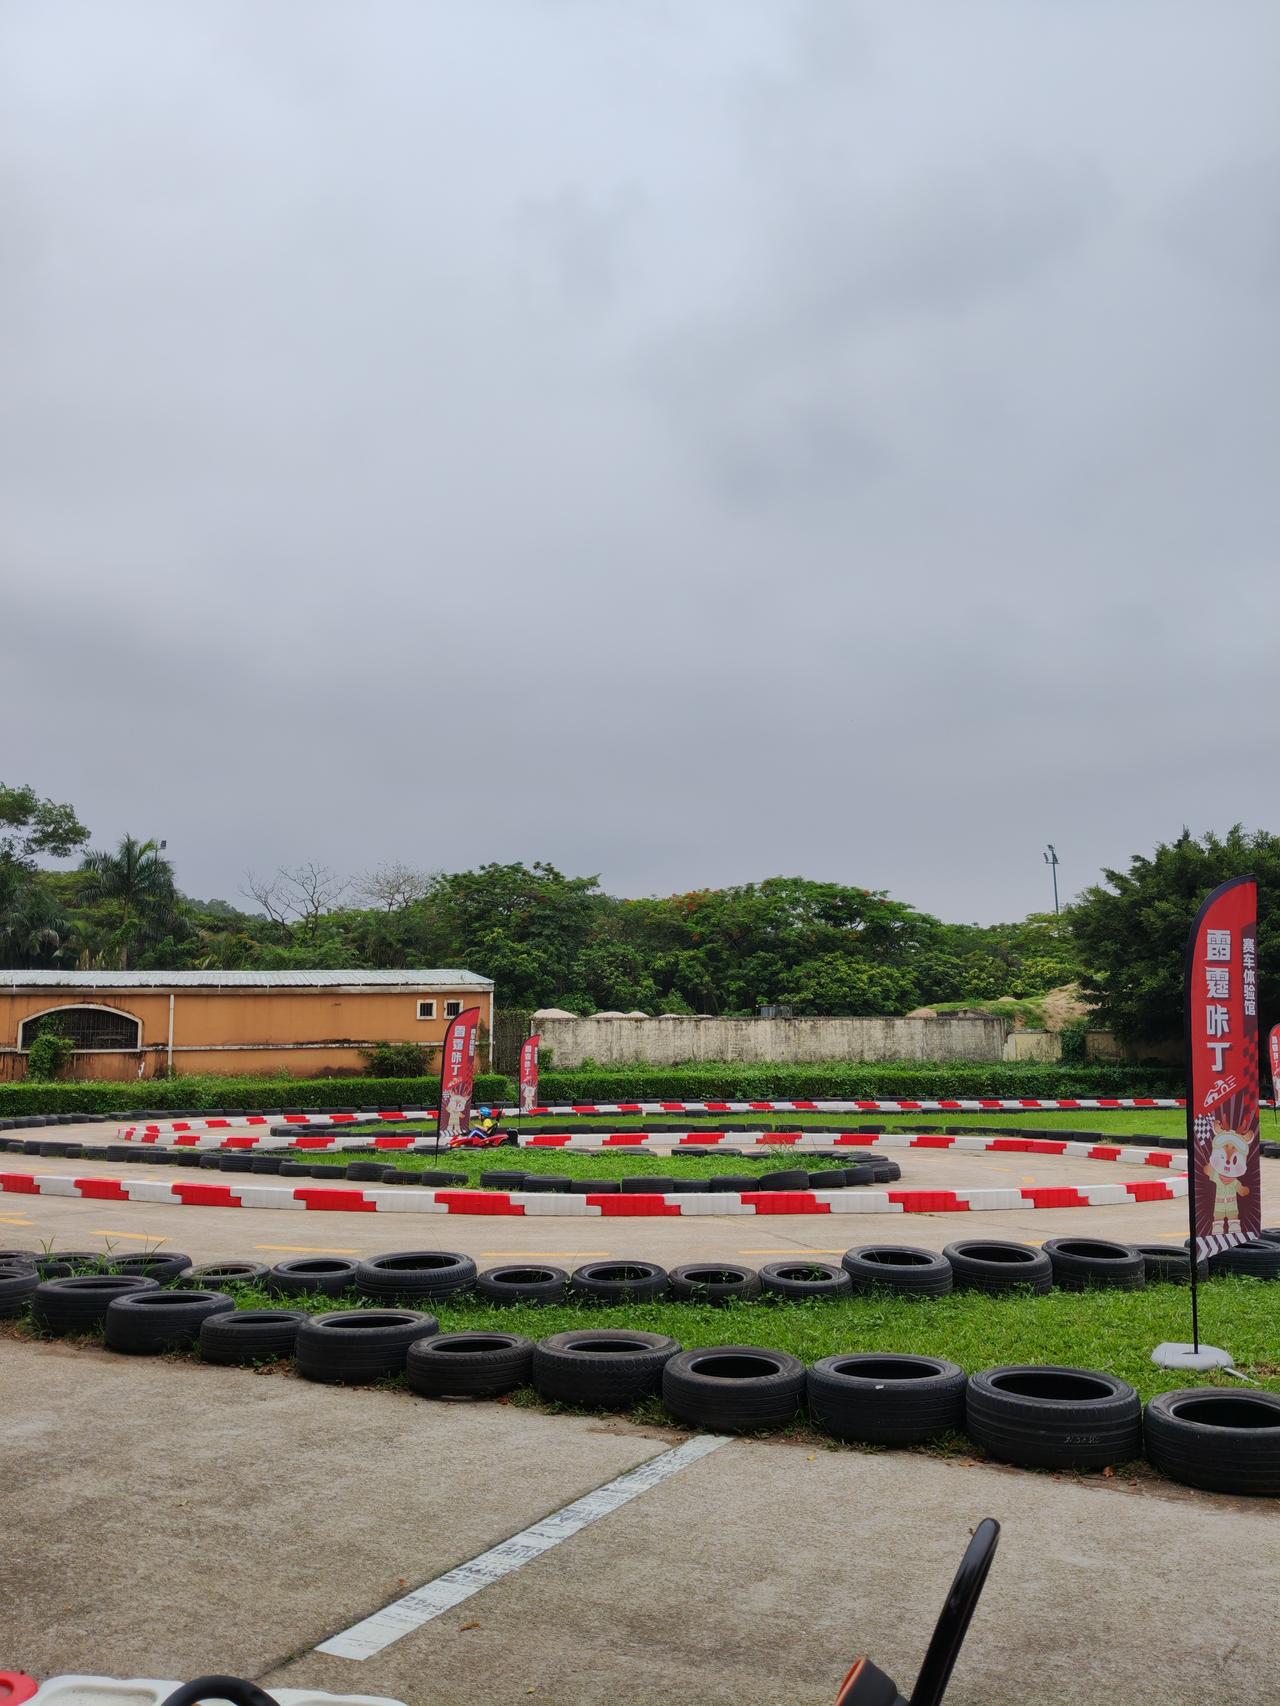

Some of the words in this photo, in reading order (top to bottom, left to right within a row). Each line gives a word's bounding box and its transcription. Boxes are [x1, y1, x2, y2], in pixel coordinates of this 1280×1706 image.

[1205, 929, 1231, 1072] 雷霆咔丁
[1242, 938, 1256, 1016] 赛车体验馆
